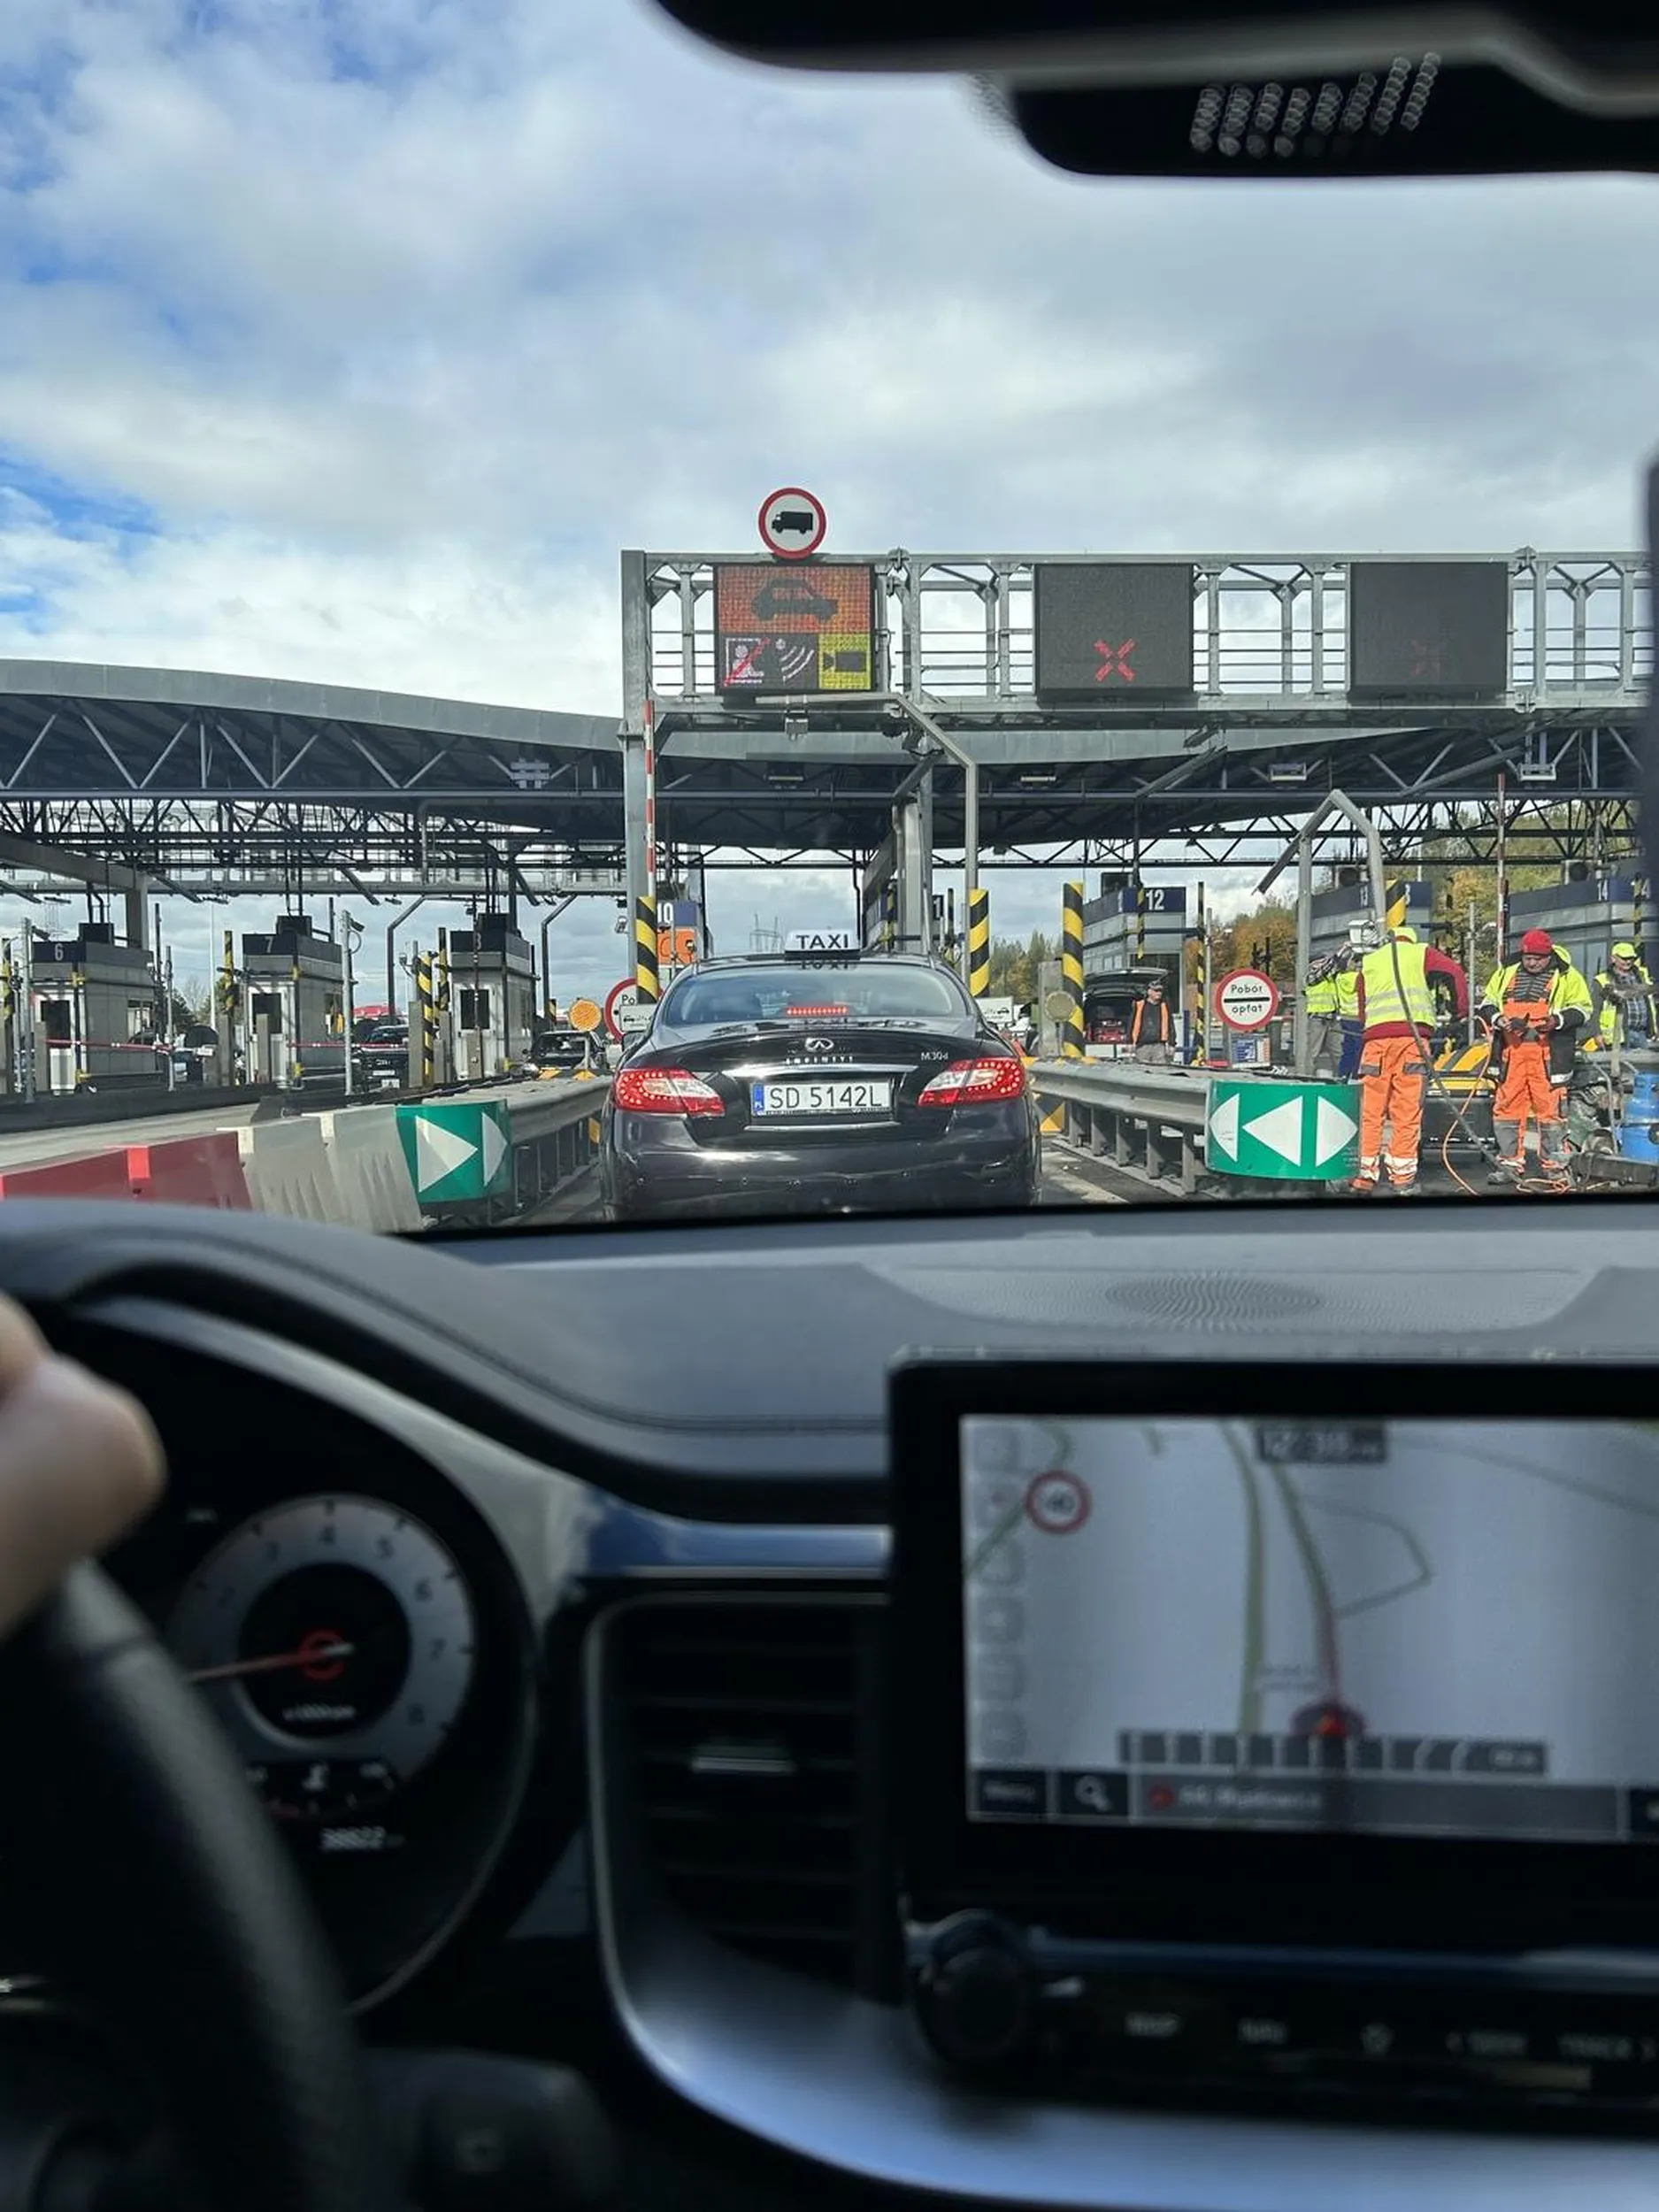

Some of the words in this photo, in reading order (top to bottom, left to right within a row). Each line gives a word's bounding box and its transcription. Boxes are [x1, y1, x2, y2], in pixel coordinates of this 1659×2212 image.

[1145, 889, 1165, 910] 12
[657, 902, 673, 924] 10
[264, 936, 273, 953] 7
[795, 933, 849, 950] TAXI
[54, 942, 64, 961] 6
[1231, 982, 1263, 995] Pobór
[769, 1087, 800, 1109] SD
[810, 1085, 883, 1109] 5142L
